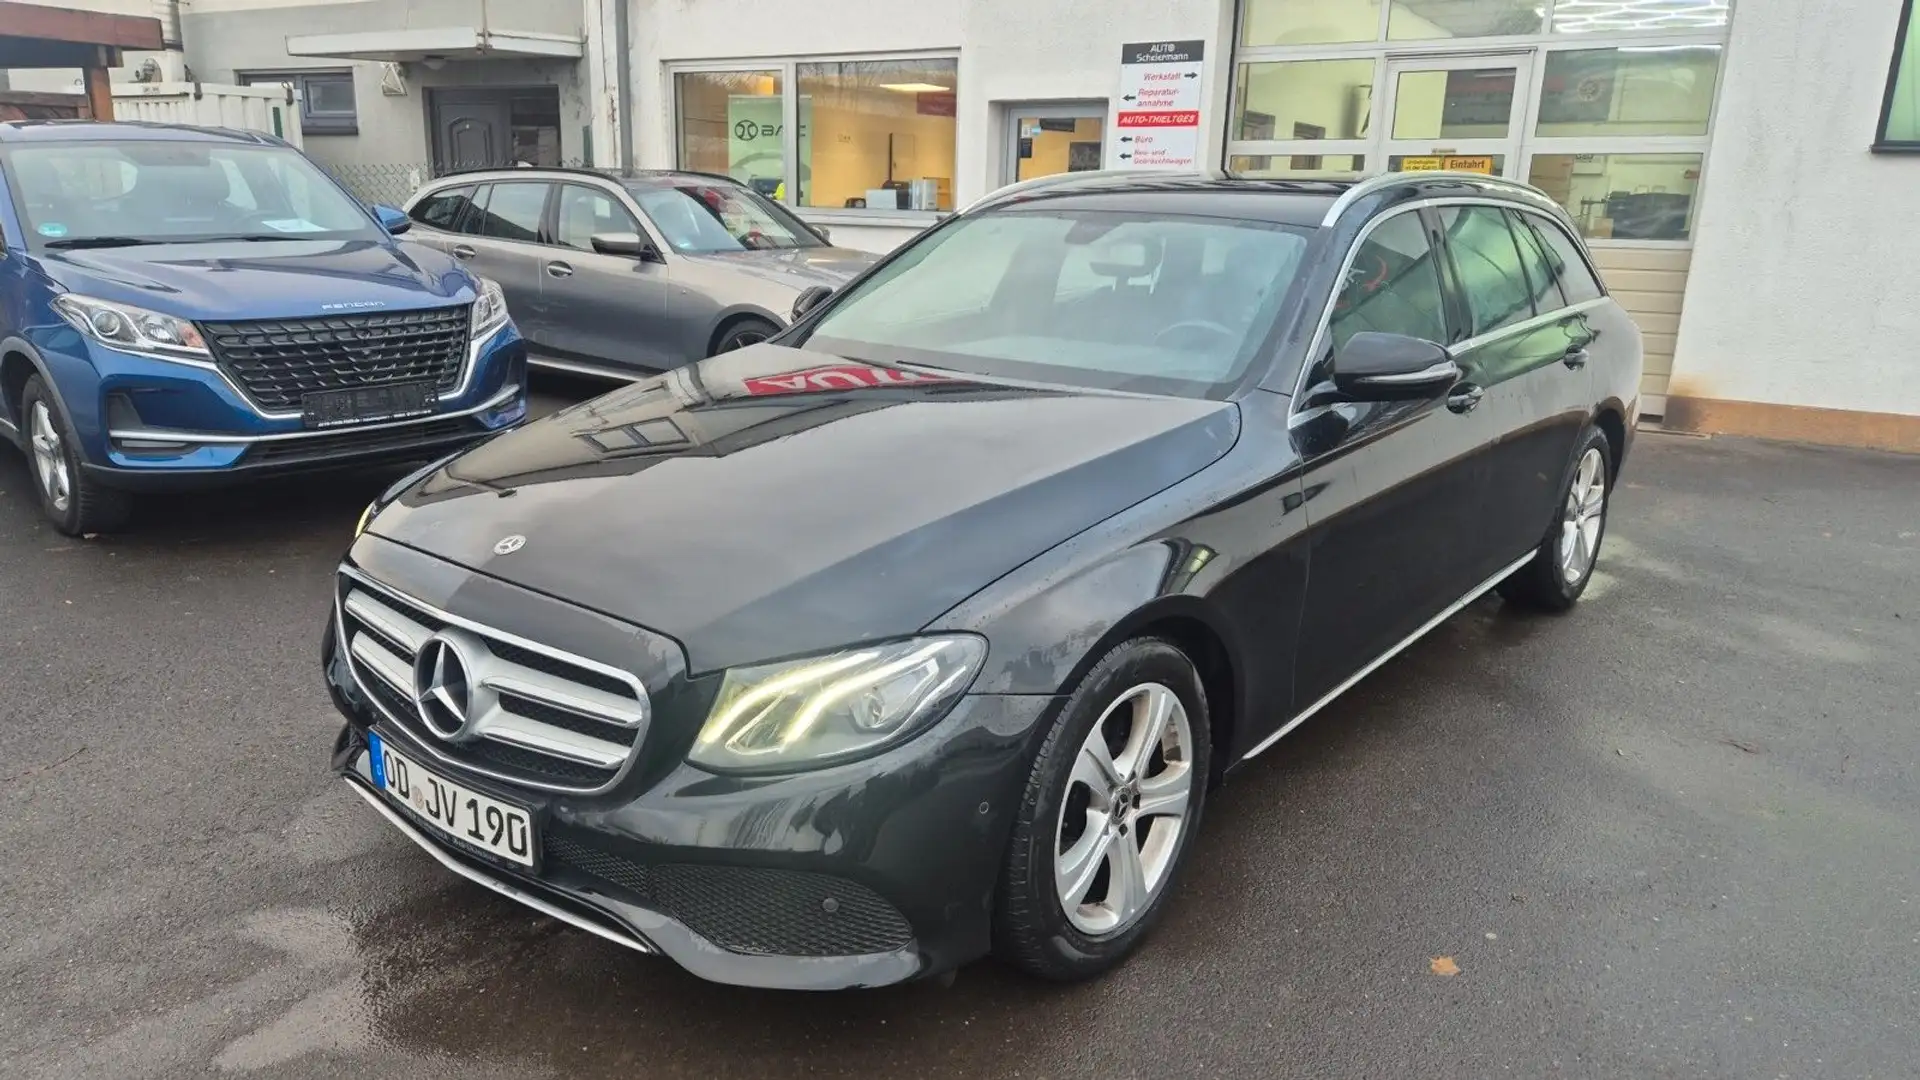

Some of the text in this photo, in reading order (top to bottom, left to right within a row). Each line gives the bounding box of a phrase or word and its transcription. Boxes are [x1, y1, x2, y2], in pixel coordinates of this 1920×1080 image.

[1149, 43, 1175, 53] AUTO
[1143, 73, 1181, 81] Werkstatt
[1121, 114, 1196, 124] AUTO-THIELTGES
[1135, 136, 1153, 144] Büro
[1450, 160, 1485, 169] Einfahrt
[425, 776, 457, 827] JV
[466, 798, 527, 857] 190
